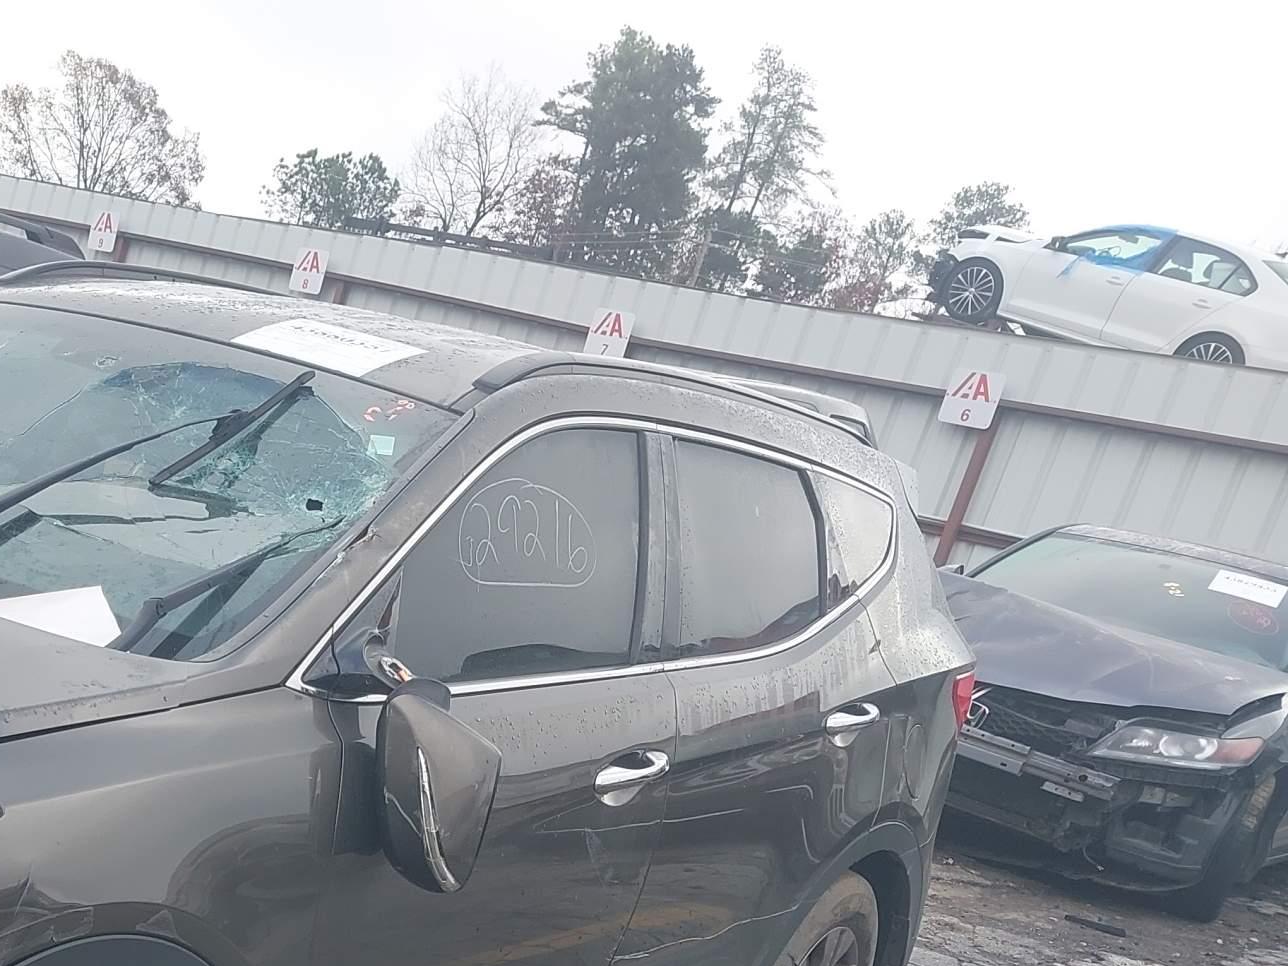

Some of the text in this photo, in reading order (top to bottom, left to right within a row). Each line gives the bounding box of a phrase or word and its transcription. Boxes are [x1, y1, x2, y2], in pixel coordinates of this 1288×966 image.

[97, 238, 104, 248] 9
[302, 279, 309, 289] 8
[600, 343, 609, 356] 7
[960, 408, 971, 422] 6
